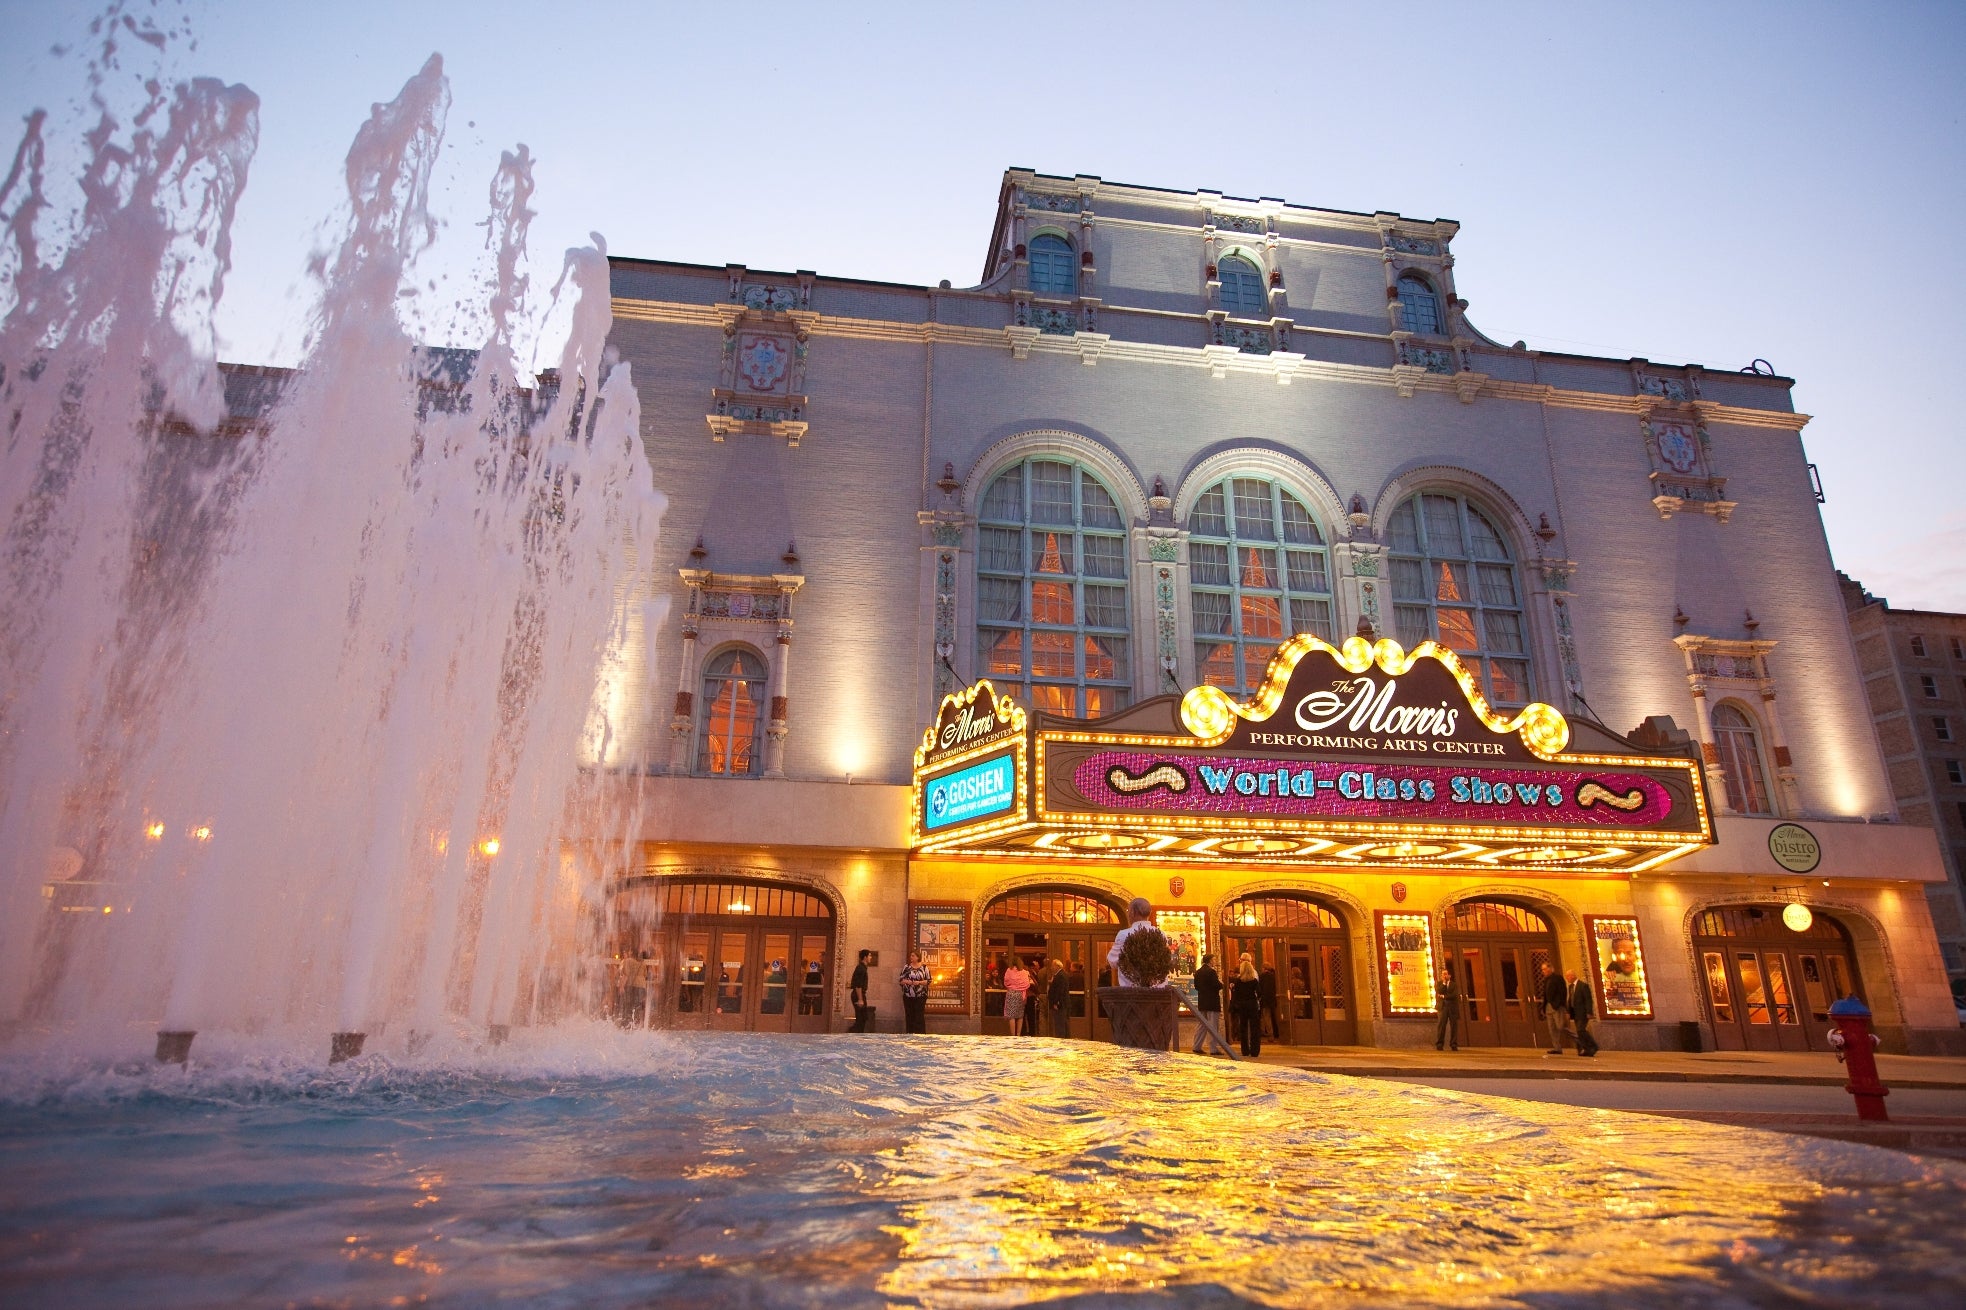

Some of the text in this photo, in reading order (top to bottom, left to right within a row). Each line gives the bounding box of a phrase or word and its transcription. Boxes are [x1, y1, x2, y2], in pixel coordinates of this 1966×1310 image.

[1294, 677, 1459, 737] The Morris
[929, 727, 1014, 764] PERFORMING ARTS CENTER
[941, 705, 995, 750] Morris
[1249, 732, 1506, 756] PERFORMING ARTS CENTER
[949, 767, 1004, 805] GOSHEN
[1198, 765, 1563, 806] World-Class Shows
[1773, 839, 1816, 854] bistro
[1597, 923, 1630, 935] ROBIN
